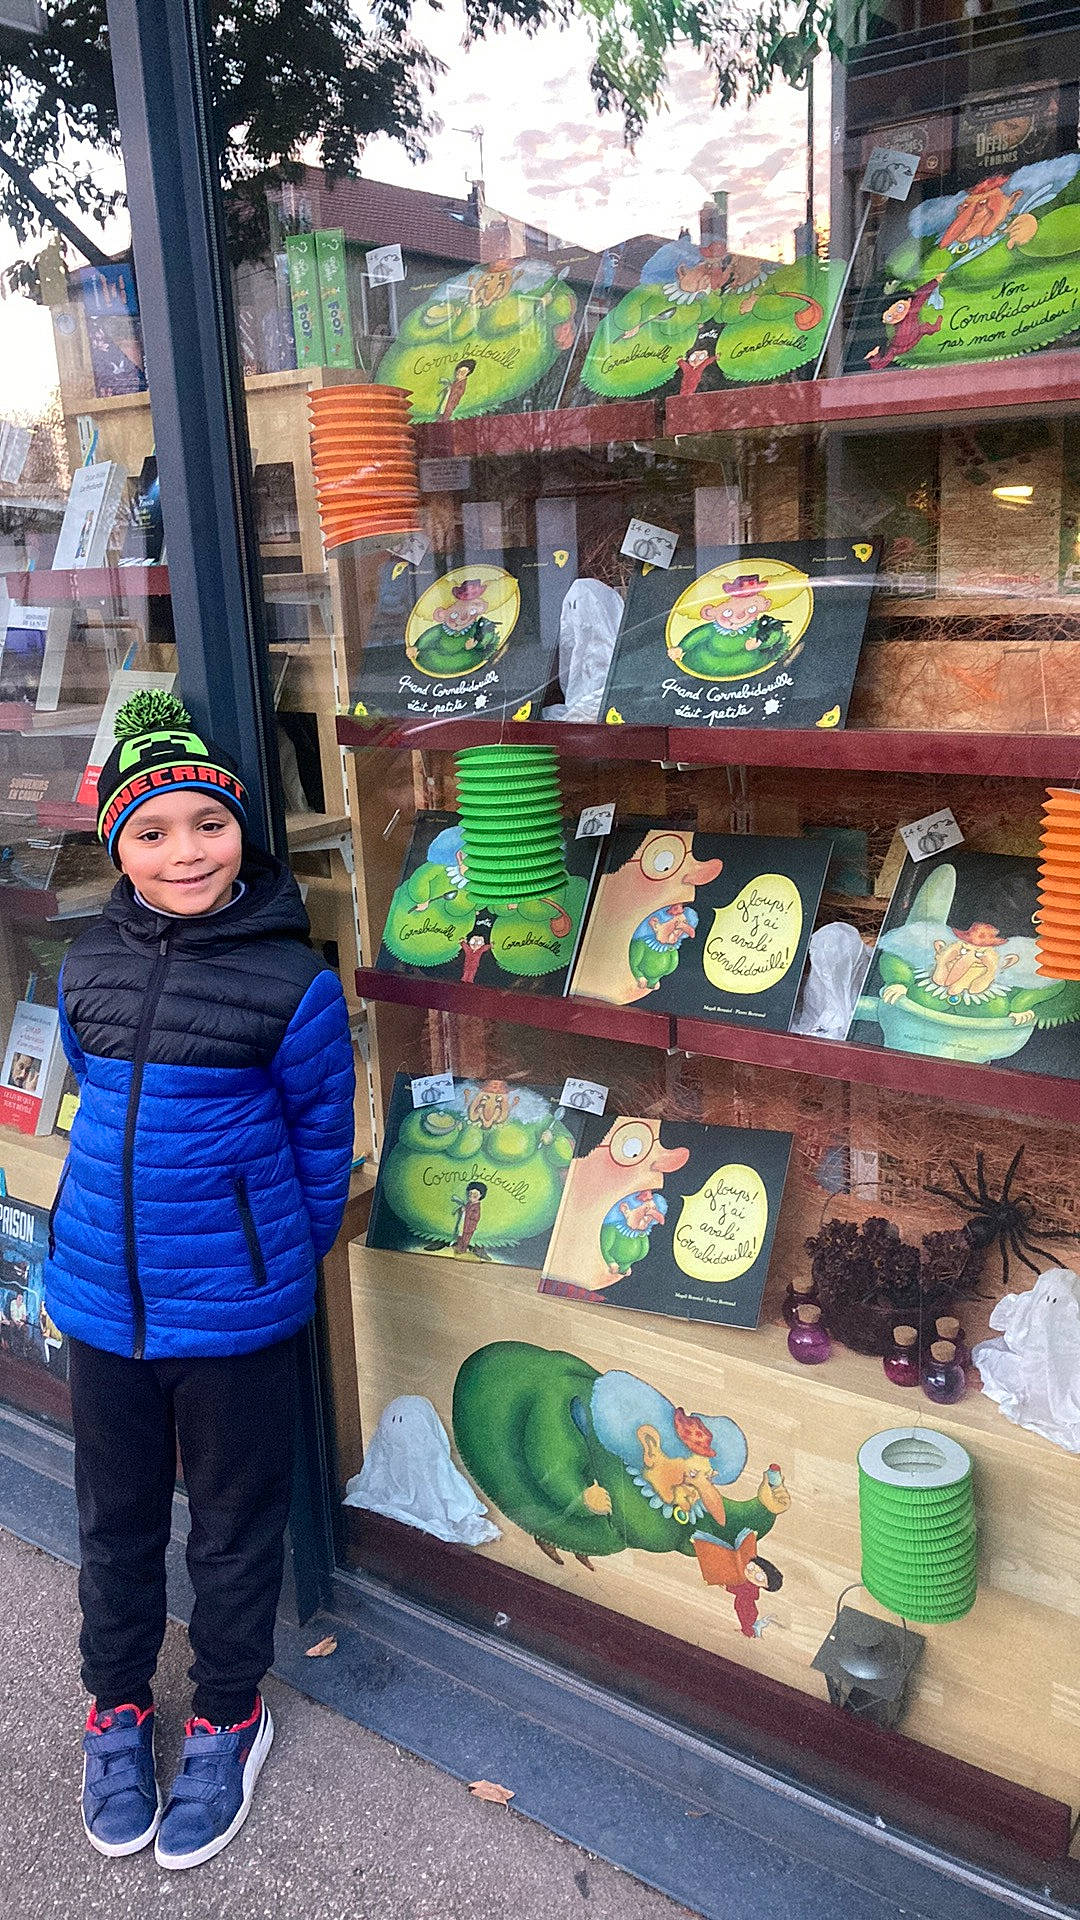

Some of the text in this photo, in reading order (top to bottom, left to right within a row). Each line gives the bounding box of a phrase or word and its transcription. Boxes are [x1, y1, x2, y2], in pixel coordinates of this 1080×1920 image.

[992, 281, 1029, 299] Non
[730, 332, 808, 359] Cornebidouille
[938, 338, 965, 353] pas
[967, 330, 1006, 346] mon
[413, 343, 521, 375] Cornebidouille
[601, 343, 672, 375] Cornebidouille
[432, 670, 500, 698] Cornebidouille
[661, 672, 795, 702] Quand Cornebidouille
[428, 698, 468, 717] petite
[674, 703, 754, 726] était petite
[103, 766, 244, 839] MINECRAFT
[399, 918, 456, 941] Cornebidouille
[731, 933, 773, 952] avalé
[502, 932, 561, 957] Cornebidouille
[423, 1164, 530, 1204] Cornebidouille
[704, 1179, 758, 1211] gloups!
[700, 1222, 740, 1241] avalé
